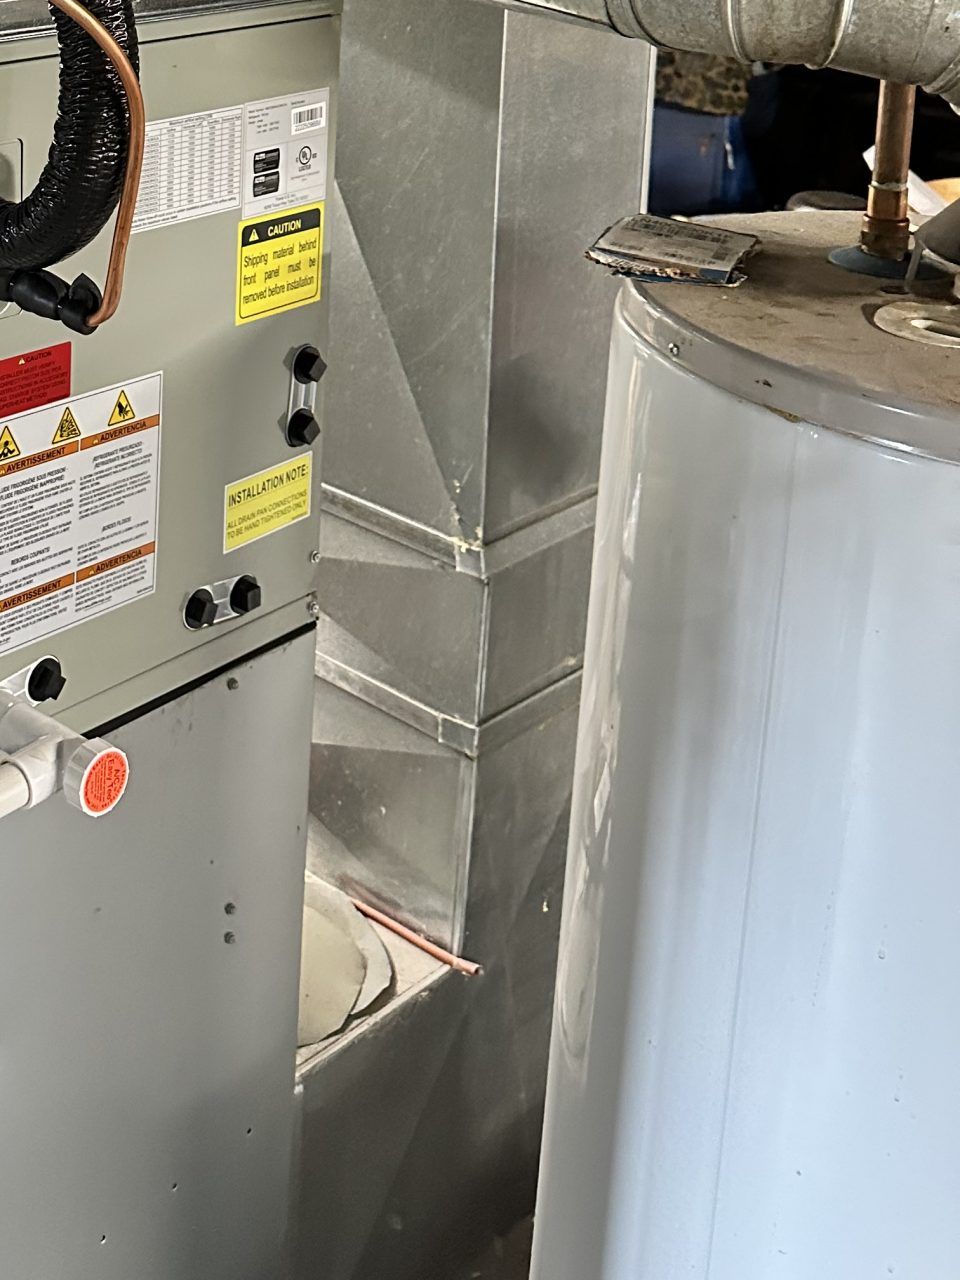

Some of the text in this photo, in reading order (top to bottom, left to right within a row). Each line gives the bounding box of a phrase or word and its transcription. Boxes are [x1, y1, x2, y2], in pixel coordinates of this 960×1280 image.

[268, 219, 301, 237] CAUTION
[244, 238, 317, 268] Shipping material behind
[243, 257, 316, 286] front panel must be
[242, 276, 314, 304] removed before installation
[26, 351, 52, 363] CAUTION
[100, 421, 147, 441] ADVERTENCIA
[6, 447, 66, 472] AVERTISSEMENT
[228, 464, 309, 507] INSTALLATION NOTE:
[227, 489, 307, 529] ALL DRAIN PAN CONNECTIONS
[227, 531, 235, 539] TO
[236, 527, 243, 536] BE
[244, 520, 260, 532] HAND
[261, 505, 292, 525] TIGHTENED
[292, 500, 306, 511] ONLY
[96, 549, 142, 573] ADVERTENCIA
[3, 580, 61, 609] AVERTISSEMENT
